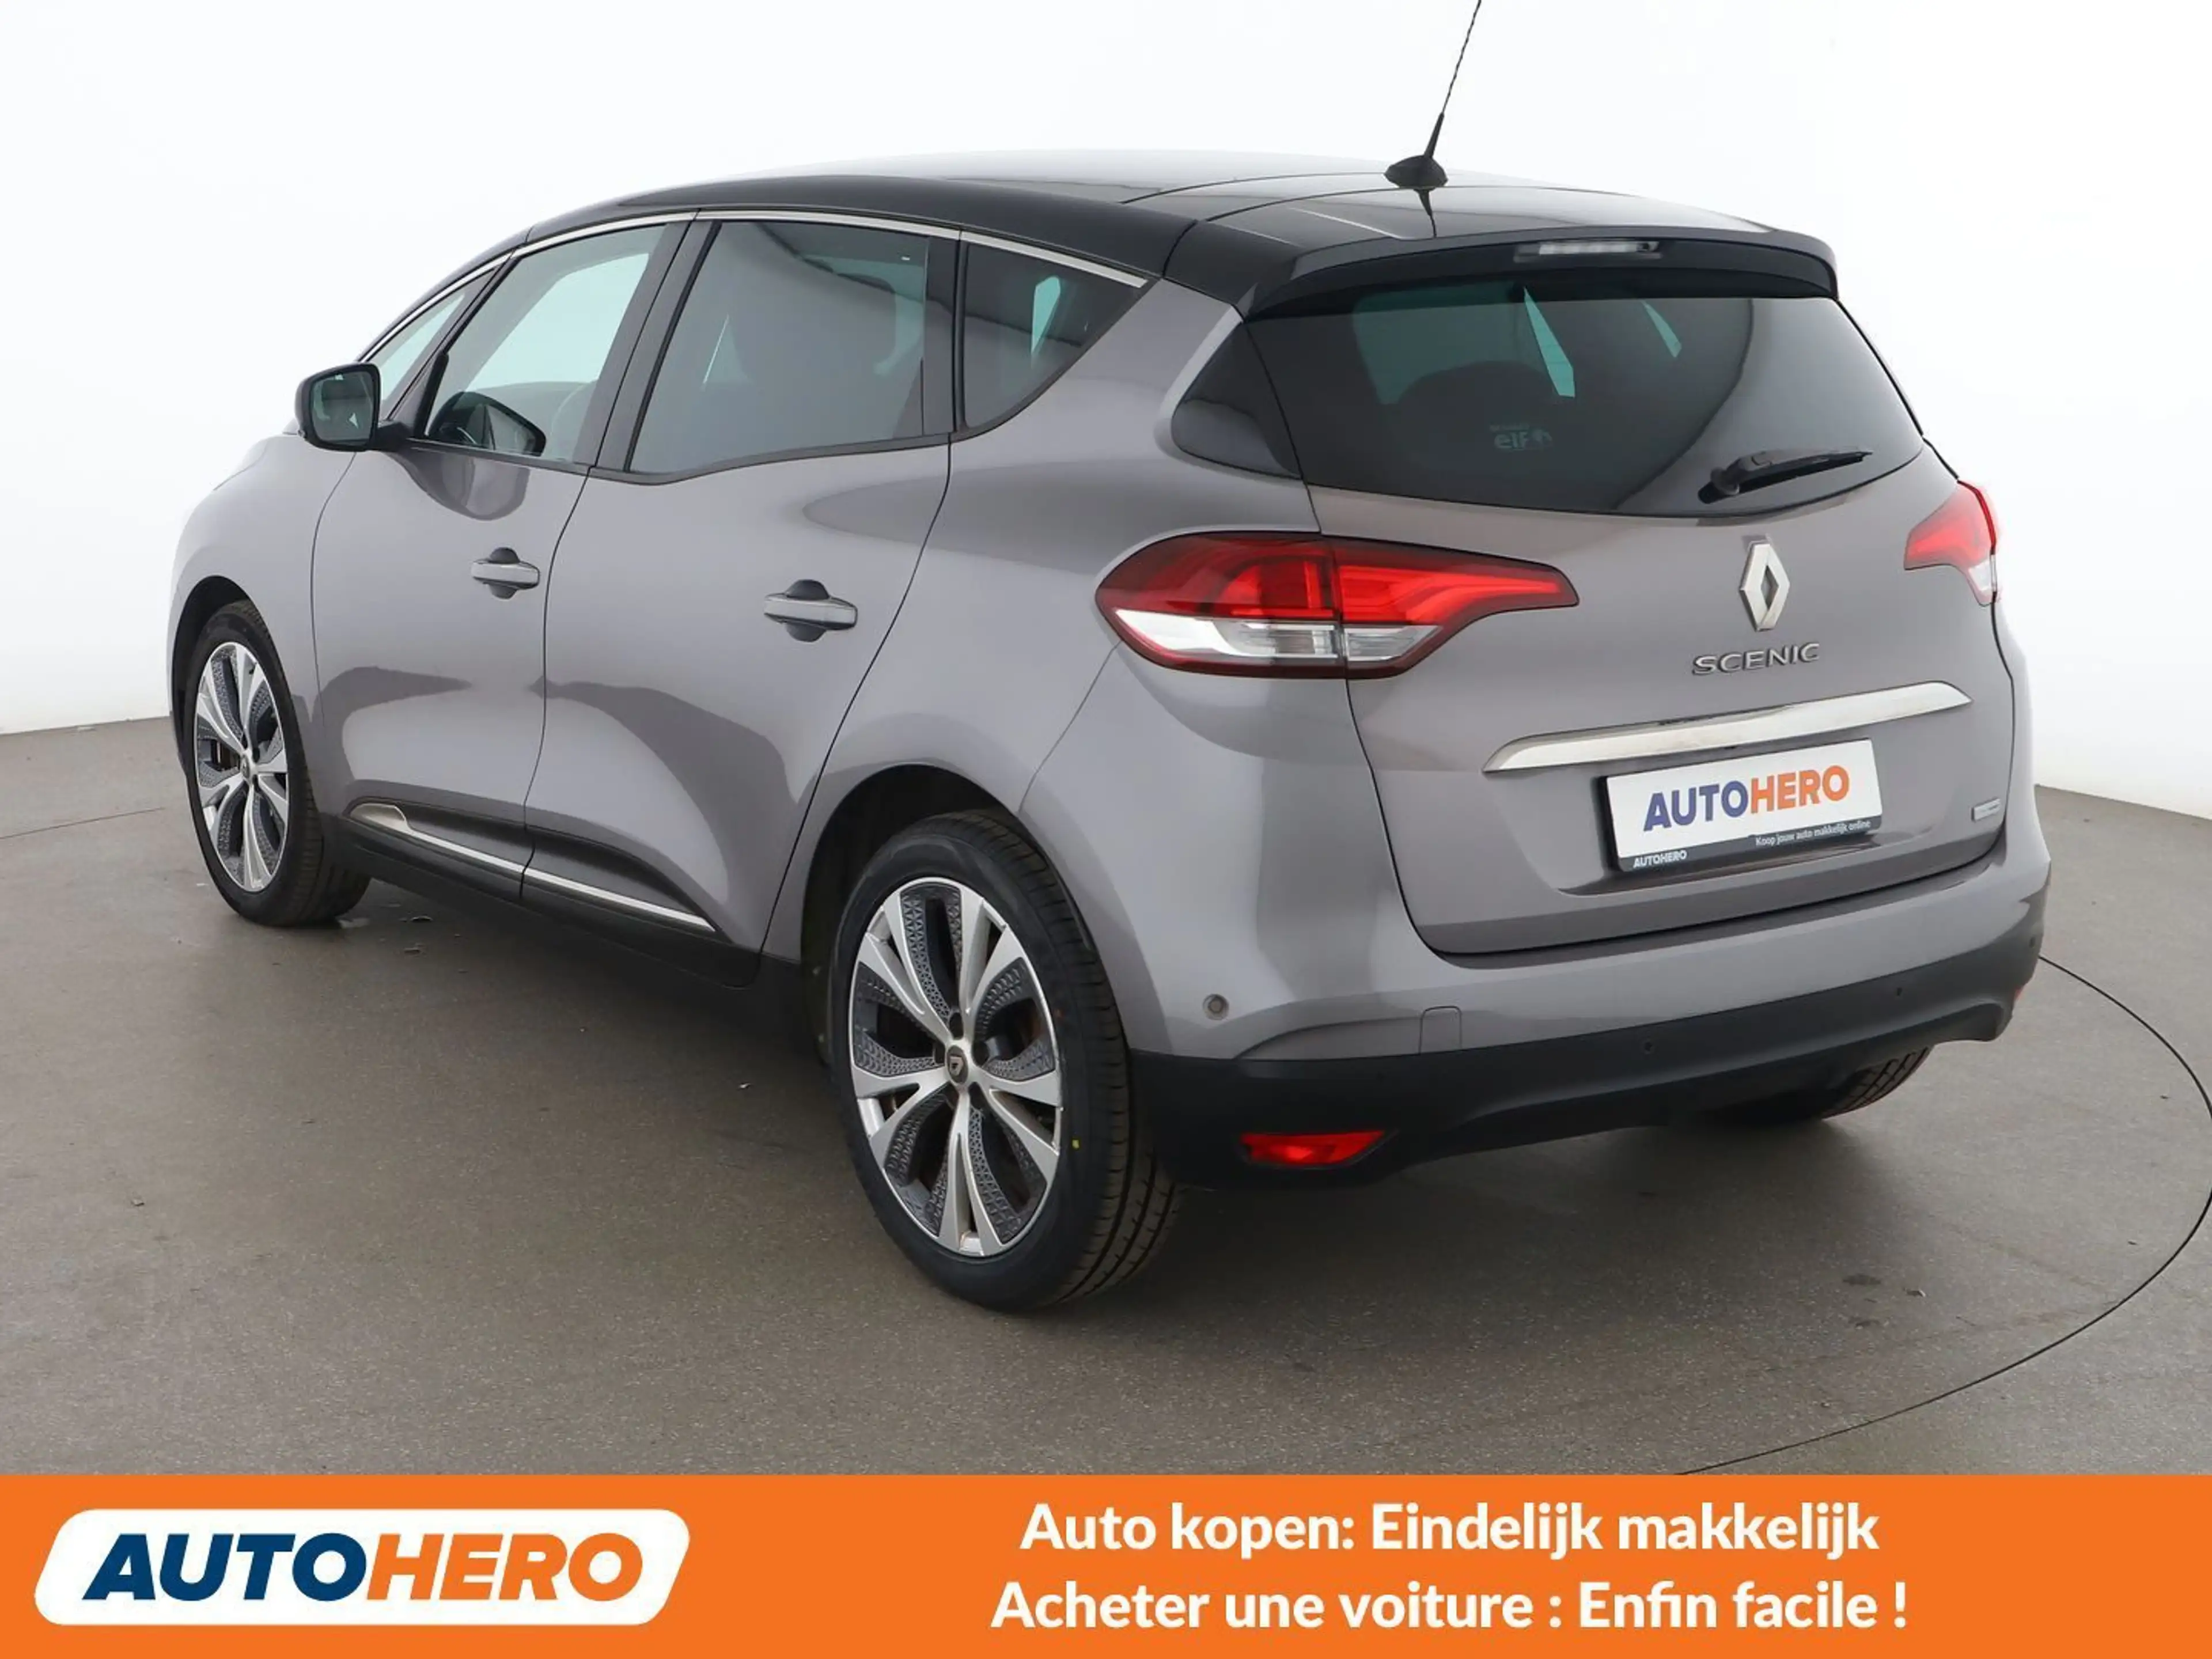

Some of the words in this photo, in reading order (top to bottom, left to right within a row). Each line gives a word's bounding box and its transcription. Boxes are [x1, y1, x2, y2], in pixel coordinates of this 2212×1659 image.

[1692, 642, 1820, 676] SCENIC
[1643, 765, 1850, 831] AUTOHERO
[1756, 836, 1775, 846] Koop
[1777, 834, 1795, 845] jouw
[1796, 830, 1813, 839] auto
[1815, 824, 1847, 837] makkelijk
[1848, 820, 1871, 831] online
[1633, 850, 1688, 868] AUTOHERO
